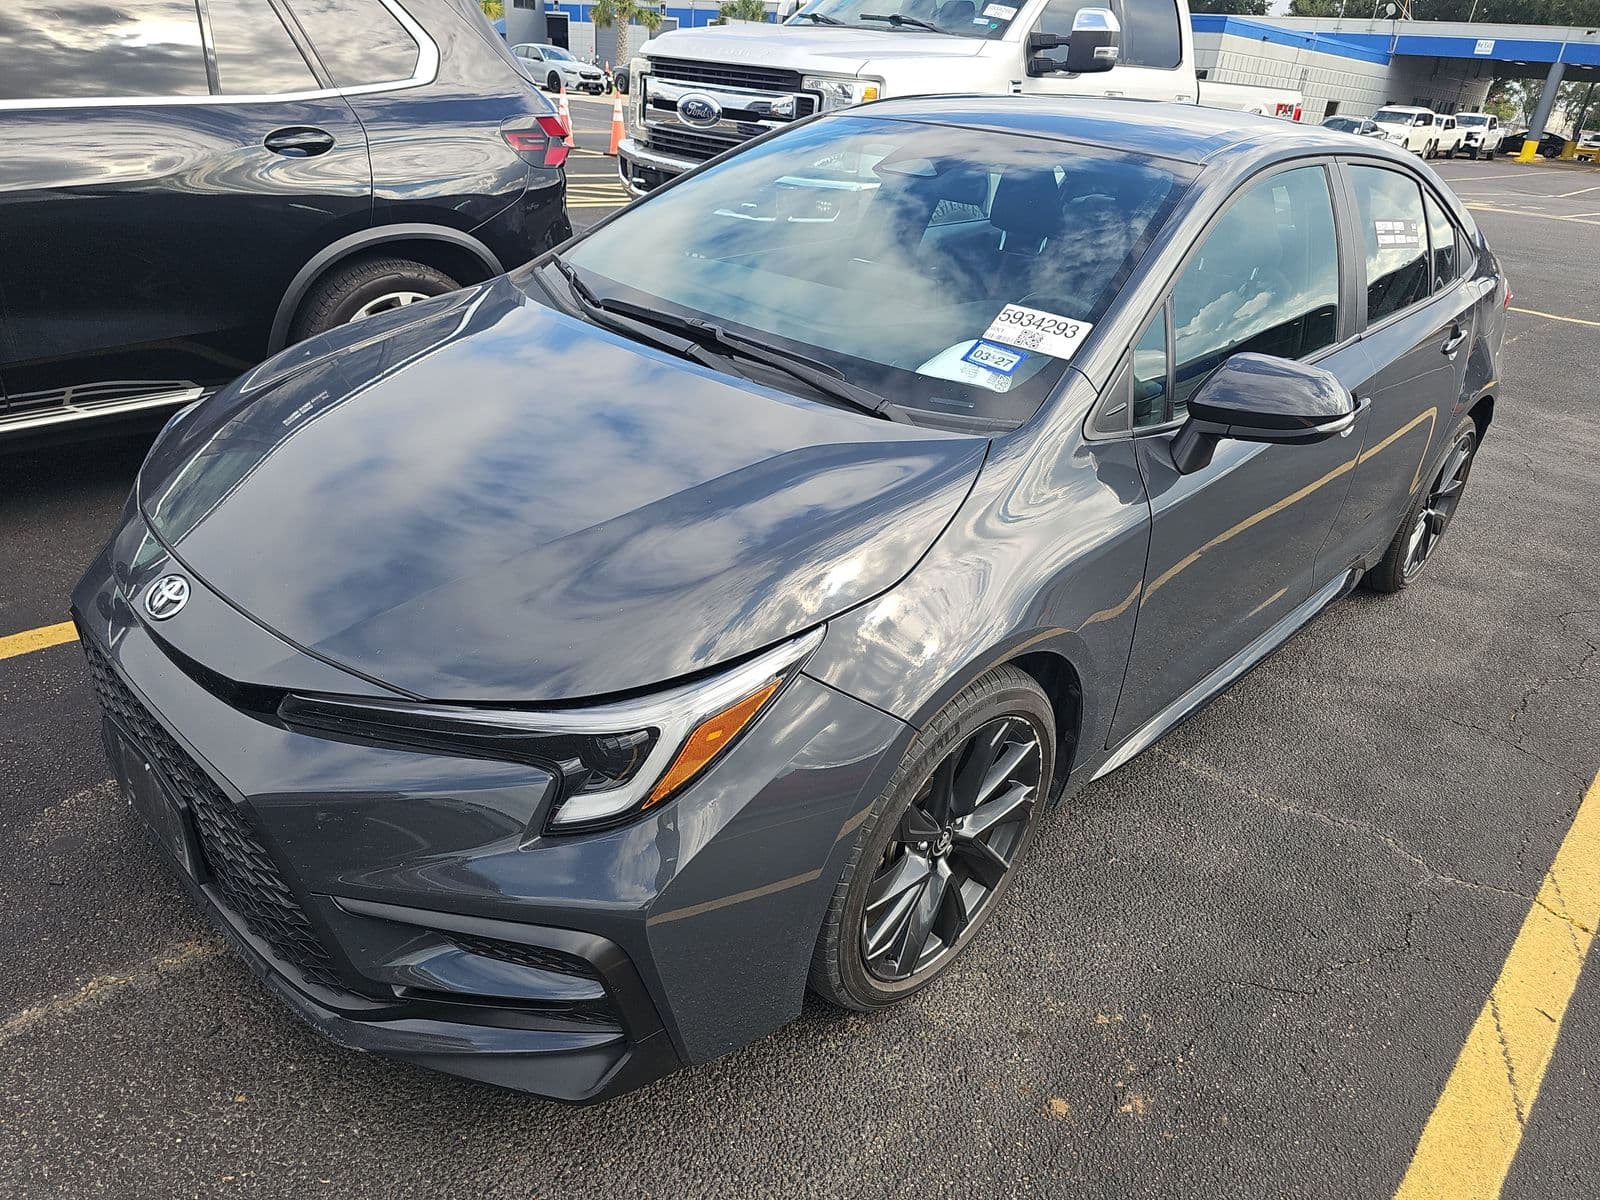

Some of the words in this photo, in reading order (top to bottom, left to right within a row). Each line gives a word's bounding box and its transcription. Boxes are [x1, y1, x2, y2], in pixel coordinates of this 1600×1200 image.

[686, 101, 708, 118] Ford
[998, 308, 1080, 339] 5934293
[973, 349, 991, 361] 03
[993, 356, 1014, 368] 27
